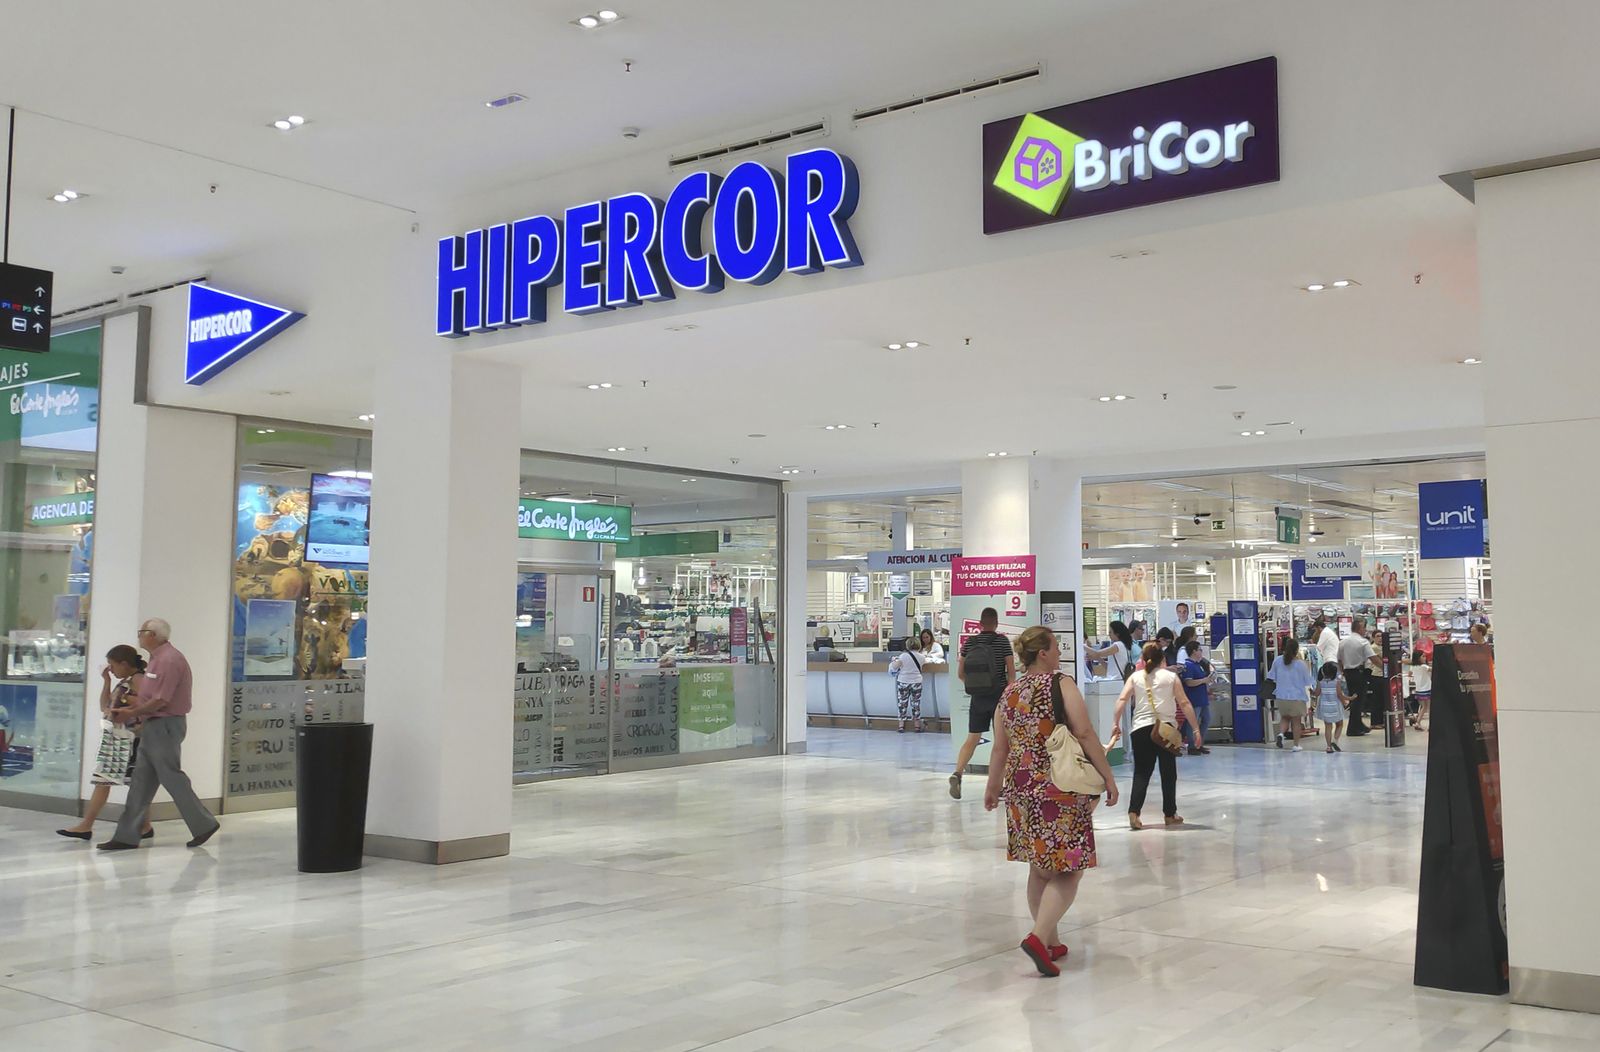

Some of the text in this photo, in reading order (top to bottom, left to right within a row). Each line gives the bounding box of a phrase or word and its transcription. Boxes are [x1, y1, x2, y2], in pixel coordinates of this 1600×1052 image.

[1074, 120, 1254, 191] BriCor
[436, 148, 863, 338] HIPERCOR
[189, 309, 252, 343] HIPERCOR
[32, 500, 94, 520] AGENCIA DE
[1426, 505, 1476, 525] unit
[531, 508, 568, 531] Corte
[568, 505, 618, 539] Inglés
[887, 554, 925, 565] ATENCION
[927, 554, 938, 563] AL
[1317, 551, 1345, 559] SALIDA
[1321, 561, 1358, 570] COMPRA
[1011, 596, 1021, 609] 9
[232, 687, 244, 724] YORK
[669, 686, 678, 751] CALCUTA
[553, 736, 564, 763] BALI
[230, 779, 293, 792] LA HABANA
